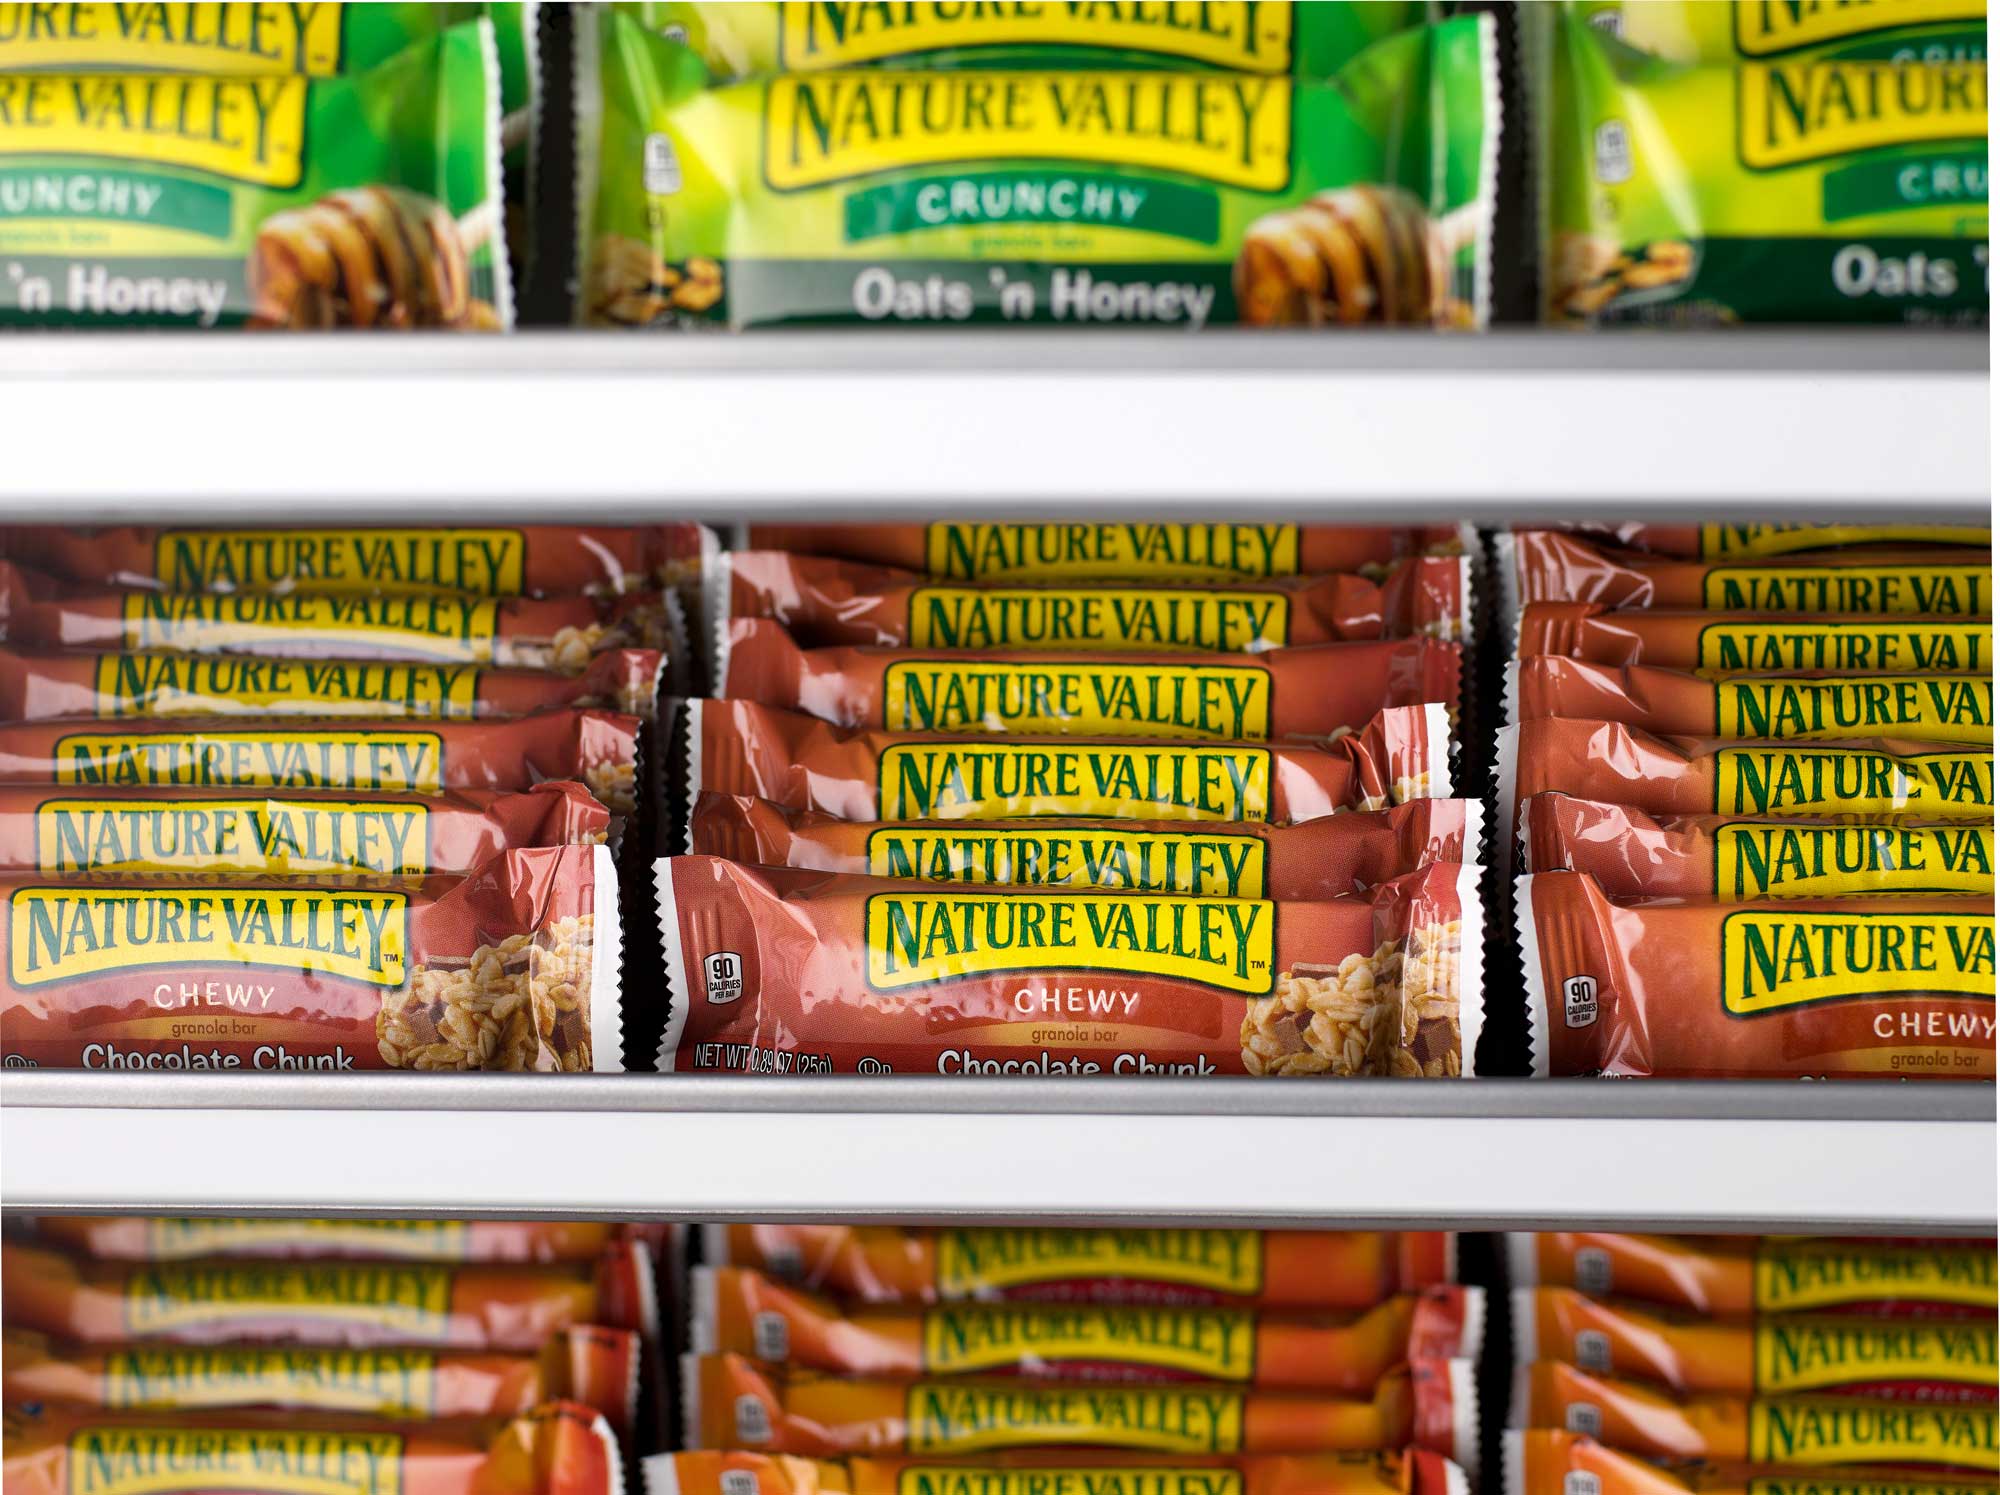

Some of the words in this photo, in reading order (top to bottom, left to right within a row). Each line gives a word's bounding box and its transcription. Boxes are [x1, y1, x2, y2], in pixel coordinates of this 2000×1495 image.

[68, 80, 291, 165] VALLEY
[789, 82, 1036, 168] NATURE
[1048, 81, 1270, 167] VALLEY
[1766, 66, 1988, 147] NATUR
[915, 179, 1147, 224] CRUNCHY
[1896, 163, 1989, 201] CRU
[67, 263, 227, 327] Honey
[1832, 244, 1959, 297] Oats
[851, 266, 975, 321] Oats
[1050, 267, 1216, 332] Honey
[174, 537, 346, 593] NATURE
[353, 537, 512, 596] VALLEY
[945, 524, 1116, 580] NATURE
[1128, 524, 1287, 577] VALLEY
[141, 592, 317, 646] NATURE
[328, 593, 482, 650] VALLEY
[928, 595, 1105, 649] NATURE
[1112, 597, 1275, 653] VALLEY
[113, 655, 292, 719] NATURE
[303, 661, 463, 720] VALLEY
[901, 671, 1083, 731] NATURE
[1089, 673, 1258, 739] VALLEY
[1734, 682, 1922, 737] NATURE
[72, 743, 255, 786] NATURE
[896, 752, 1081, 820] NATURE
[1088, 752, 1259, 822] VALLEY
[1733, 753, 1922, 814] NATURE
[1926, 760, 1994, 807] VA
[53, 808, 239, 872] NATURE
[245, 809, 416, 874] VALLEY
[886, 837, 1073, 886] NATURE
[1081, 838, 1254, 897] VALLEY
[1732, 828, 1926, 896] NATURE
[26, 896, 213, 973] NATURE
[220, 897, 395, 973] VALLEY
[884, 899, 1077, 975] NATURE
[1084, 901, 1263, 981] VALLEY
[1742, 923, 1938, 1000] NATURE
[152, 982, 276, 1009] CHEWY
[709, 979, 741, 992] CALORIES
[712, 957, 734, 980] 90
[714, 990, 725, 1000] PER
[725, 989, 736, 999] BAR
[1570, 980, 1592, 1004] 90
[171, 1018, 229, 1039] granola
[232, 1020, 257, 1036] bar
[1013, 987, 1139, 1016] CHEWY
[1567, 1002, 1597, 1016] CALORIES
[1572, 1014, 1581, 1023] PER
[1873, 1011, 1996, 1039] CHEWY
[81, 1042, 241, 1070] Chocolate
[252, 1044, 355, 1071] Chunk
[694, 1043, 723, 1068] NET
[726, 1044, 750, 1070] WT
[751, 1046, 775, 1073] 0.89
[796, 1053, 833, 1074] (25g)
[936, 1047, 1101, 1075] Chocolate
[1113, 1050, 1217, 1076] Chunk
[1030, 1023, 1089, 1045] granola
[1092, 1025, 1119, 1042] bar
[1890, 1050, 1949, 1070] granola
[1953, 1051, 1981, 1067] bar
[1772, 1325, 1929, 1383] NATURE
[922, 1391, 1079, 1447] NATURE
[1085, 1393, 1231, 1450] VALLEY
[1766, 1405, 1927, 1461] NATURE
[83, 1432, 239, 1493] NATURE
[246, 1434, 391, 1495] VALLEY
